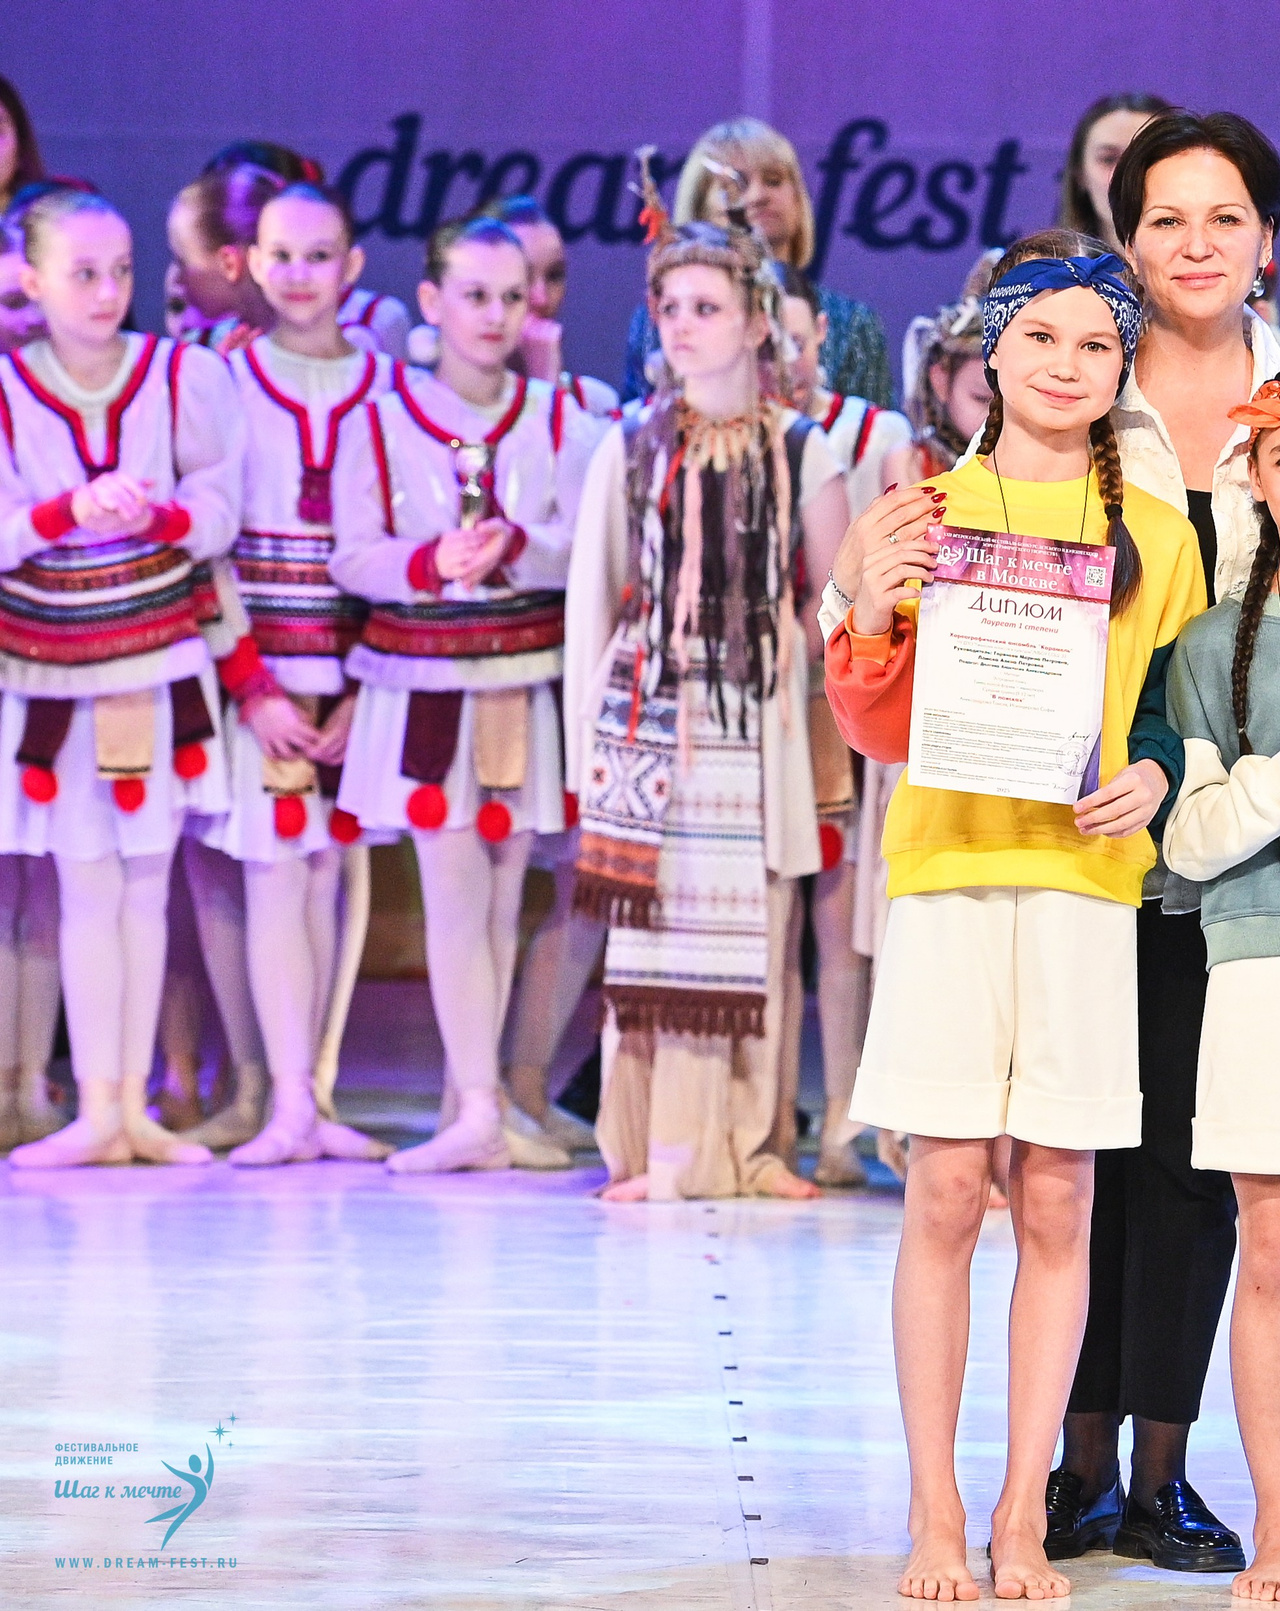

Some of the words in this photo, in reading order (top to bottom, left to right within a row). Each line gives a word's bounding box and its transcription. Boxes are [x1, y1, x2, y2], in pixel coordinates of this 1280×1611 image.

[335, 111, 692, 244] drea
[803, 116, 1030, 282] fest
[965, 547, 1004, 566] Шаг
[1007, 557, 1018, 569] к
[1021, 558, 1073, 576] мечте
[976, 570, 986, 581] в
[991, 567, 1058, 591] Москве
[981, 617, 1017, 629] Лауреат
[1024, 623, 1059, 634] степени
